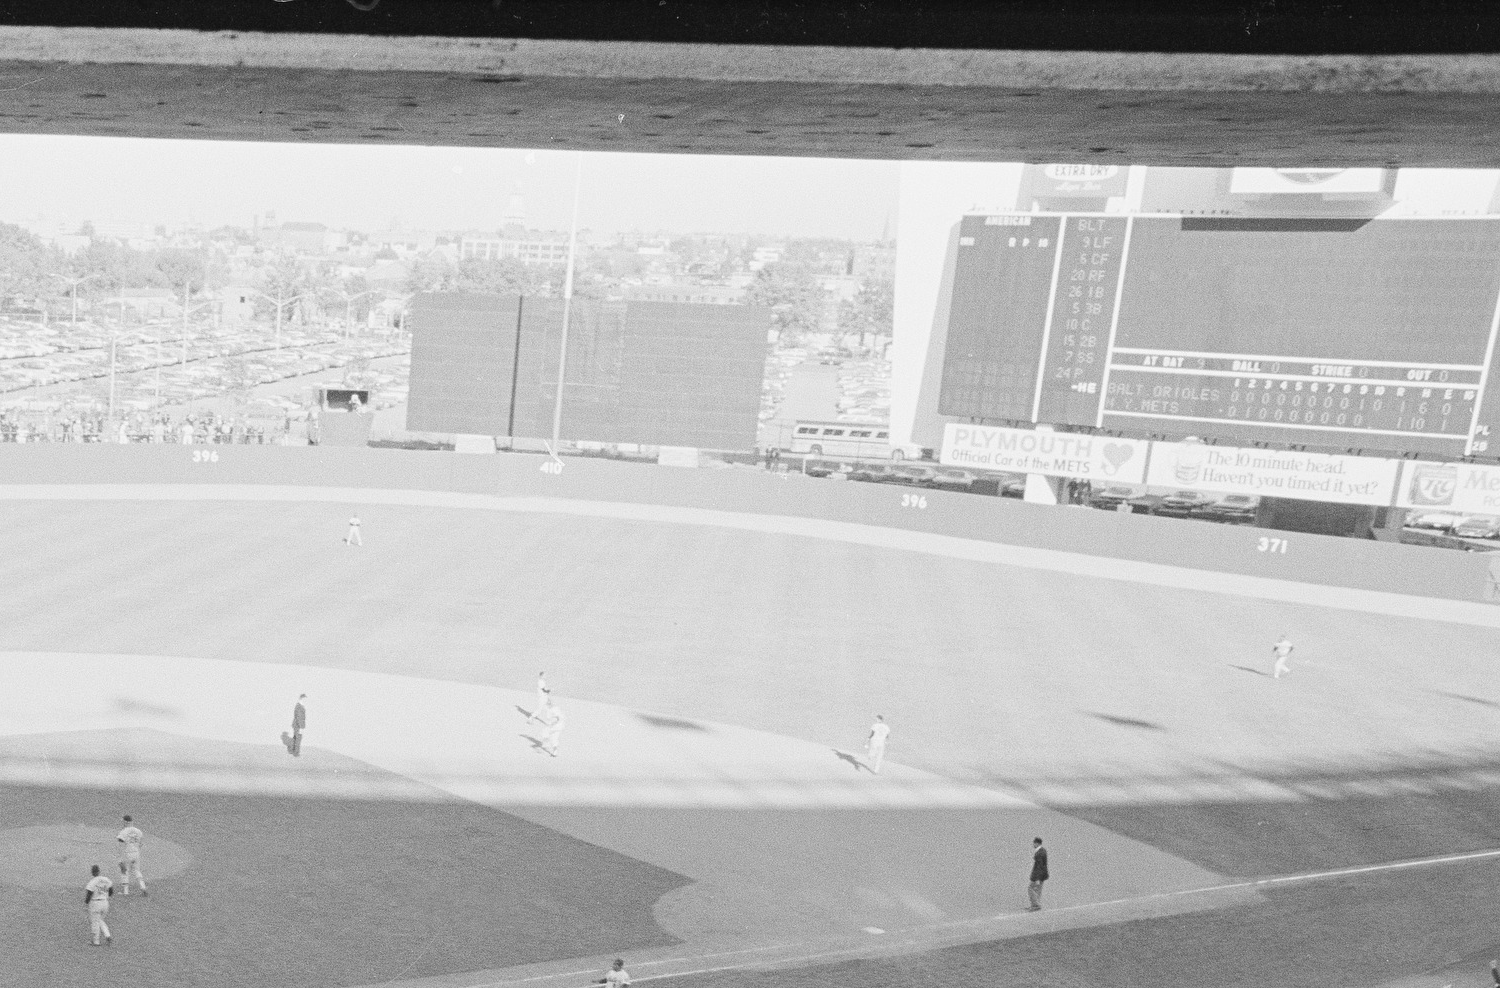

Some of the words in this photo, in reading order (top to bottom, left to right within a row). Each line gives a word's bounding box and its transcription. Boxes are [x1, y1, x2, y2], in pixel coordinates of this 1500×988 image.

[1054, 165, 1086, 177] EXTRA
[984, 216, 1032, 226] AMERICAN
[1093, 237, 1113, 249] LF
[1090, 253, 1110, 265] CF
[1088, 269, 1107, 282] RF
[1068, 286, 1083, 298] 26
[1084, 302, 1102, 315] 3B
[1081, 319, 1092, 331] C
[1065, 351, 1074, 363] 7
[1143, 356, 1159, 366] AT
[1162, 356, 1185, 368] BAT
[1055, 367, 1071, 379] 24
[1232, 360, 1261, 373] BALL
[1311, 364, 1353, 377] STRIKE
[1406, 369, 1432, 381] OUT
[1247, 379, 1257, 389] 2
[1264, 379, 1273, 390] 3
[1279, 381, 1288, 391] 4
[1310, 382, 1319, 393] 6
[1327, 383, 1336, 393] 7
[953, 427, 1093, 459] PLYMOUTH
[192, 450, 219, 464] 396
[951, 449, 991, 464] Official
[994, 454, 1014, 466] Car
[1016, 457, 1029, 468] of
[1032, 457, 1050, 471] the
[1053, 459, 1091, 474] METS
[1206, 450, 1235, 467] The
[1252, 454, 1303, 472] minute
[1305, 457, 1347, 475] head.
[540, 461, 563, 475] 410
[1201, 467, 1254, 486] Haven't
[1255, 472, 1284, 490] you
[1286, 472, 1330, 491] timed
[1332, 477, 1344, 493] it
[1347, 480, 1379, 498] yet?
[900, 493, 928, 509] 396
[1257, 537, 1288, 554] 371
